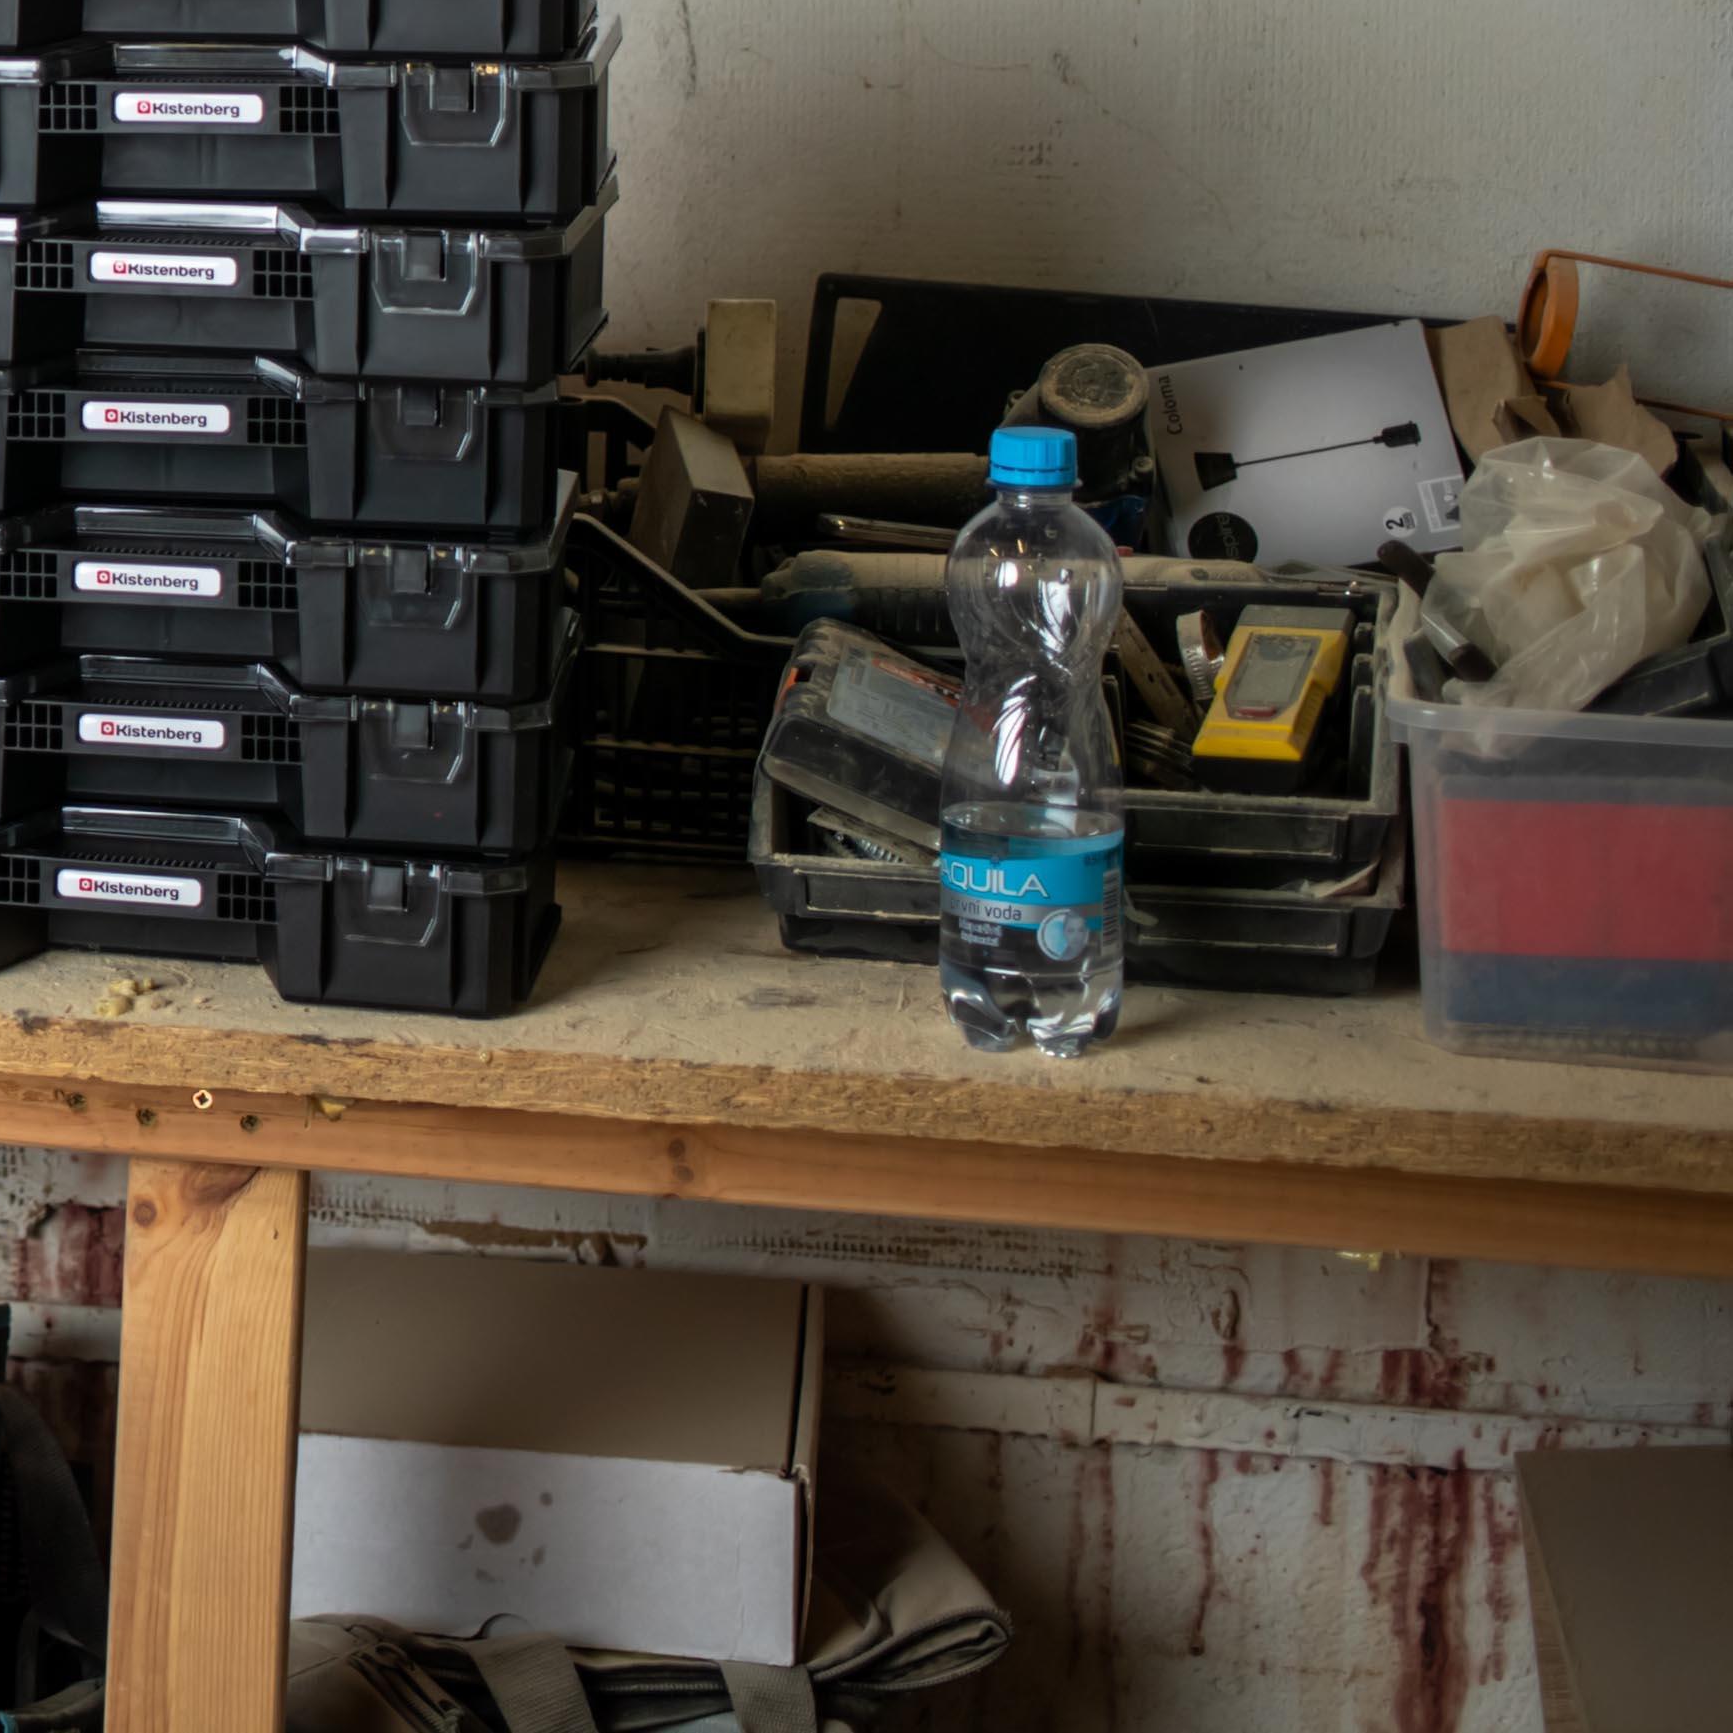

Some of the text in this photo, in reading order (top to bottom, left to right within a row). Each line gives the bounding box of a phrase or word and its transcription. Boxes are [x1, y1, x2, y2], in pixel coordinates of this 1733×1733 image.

[153, 102, 240, 118] Kistenberg
[128, 263, 215, 280] Kistenberg
[1158, 374, 1183, 436] Coloma
[120, 411, 207, 428] Kistenberg
[1385, 516, 1405, 530] 2
[112, 572, 199, 590] Kistenberg
[116, 724, 202, 743] Kistenberg
[941, 857, 1049, 897] AQUILA
[94, 881, 179, 901] Kistenberg
[984, 904, 1022, 921] voda
